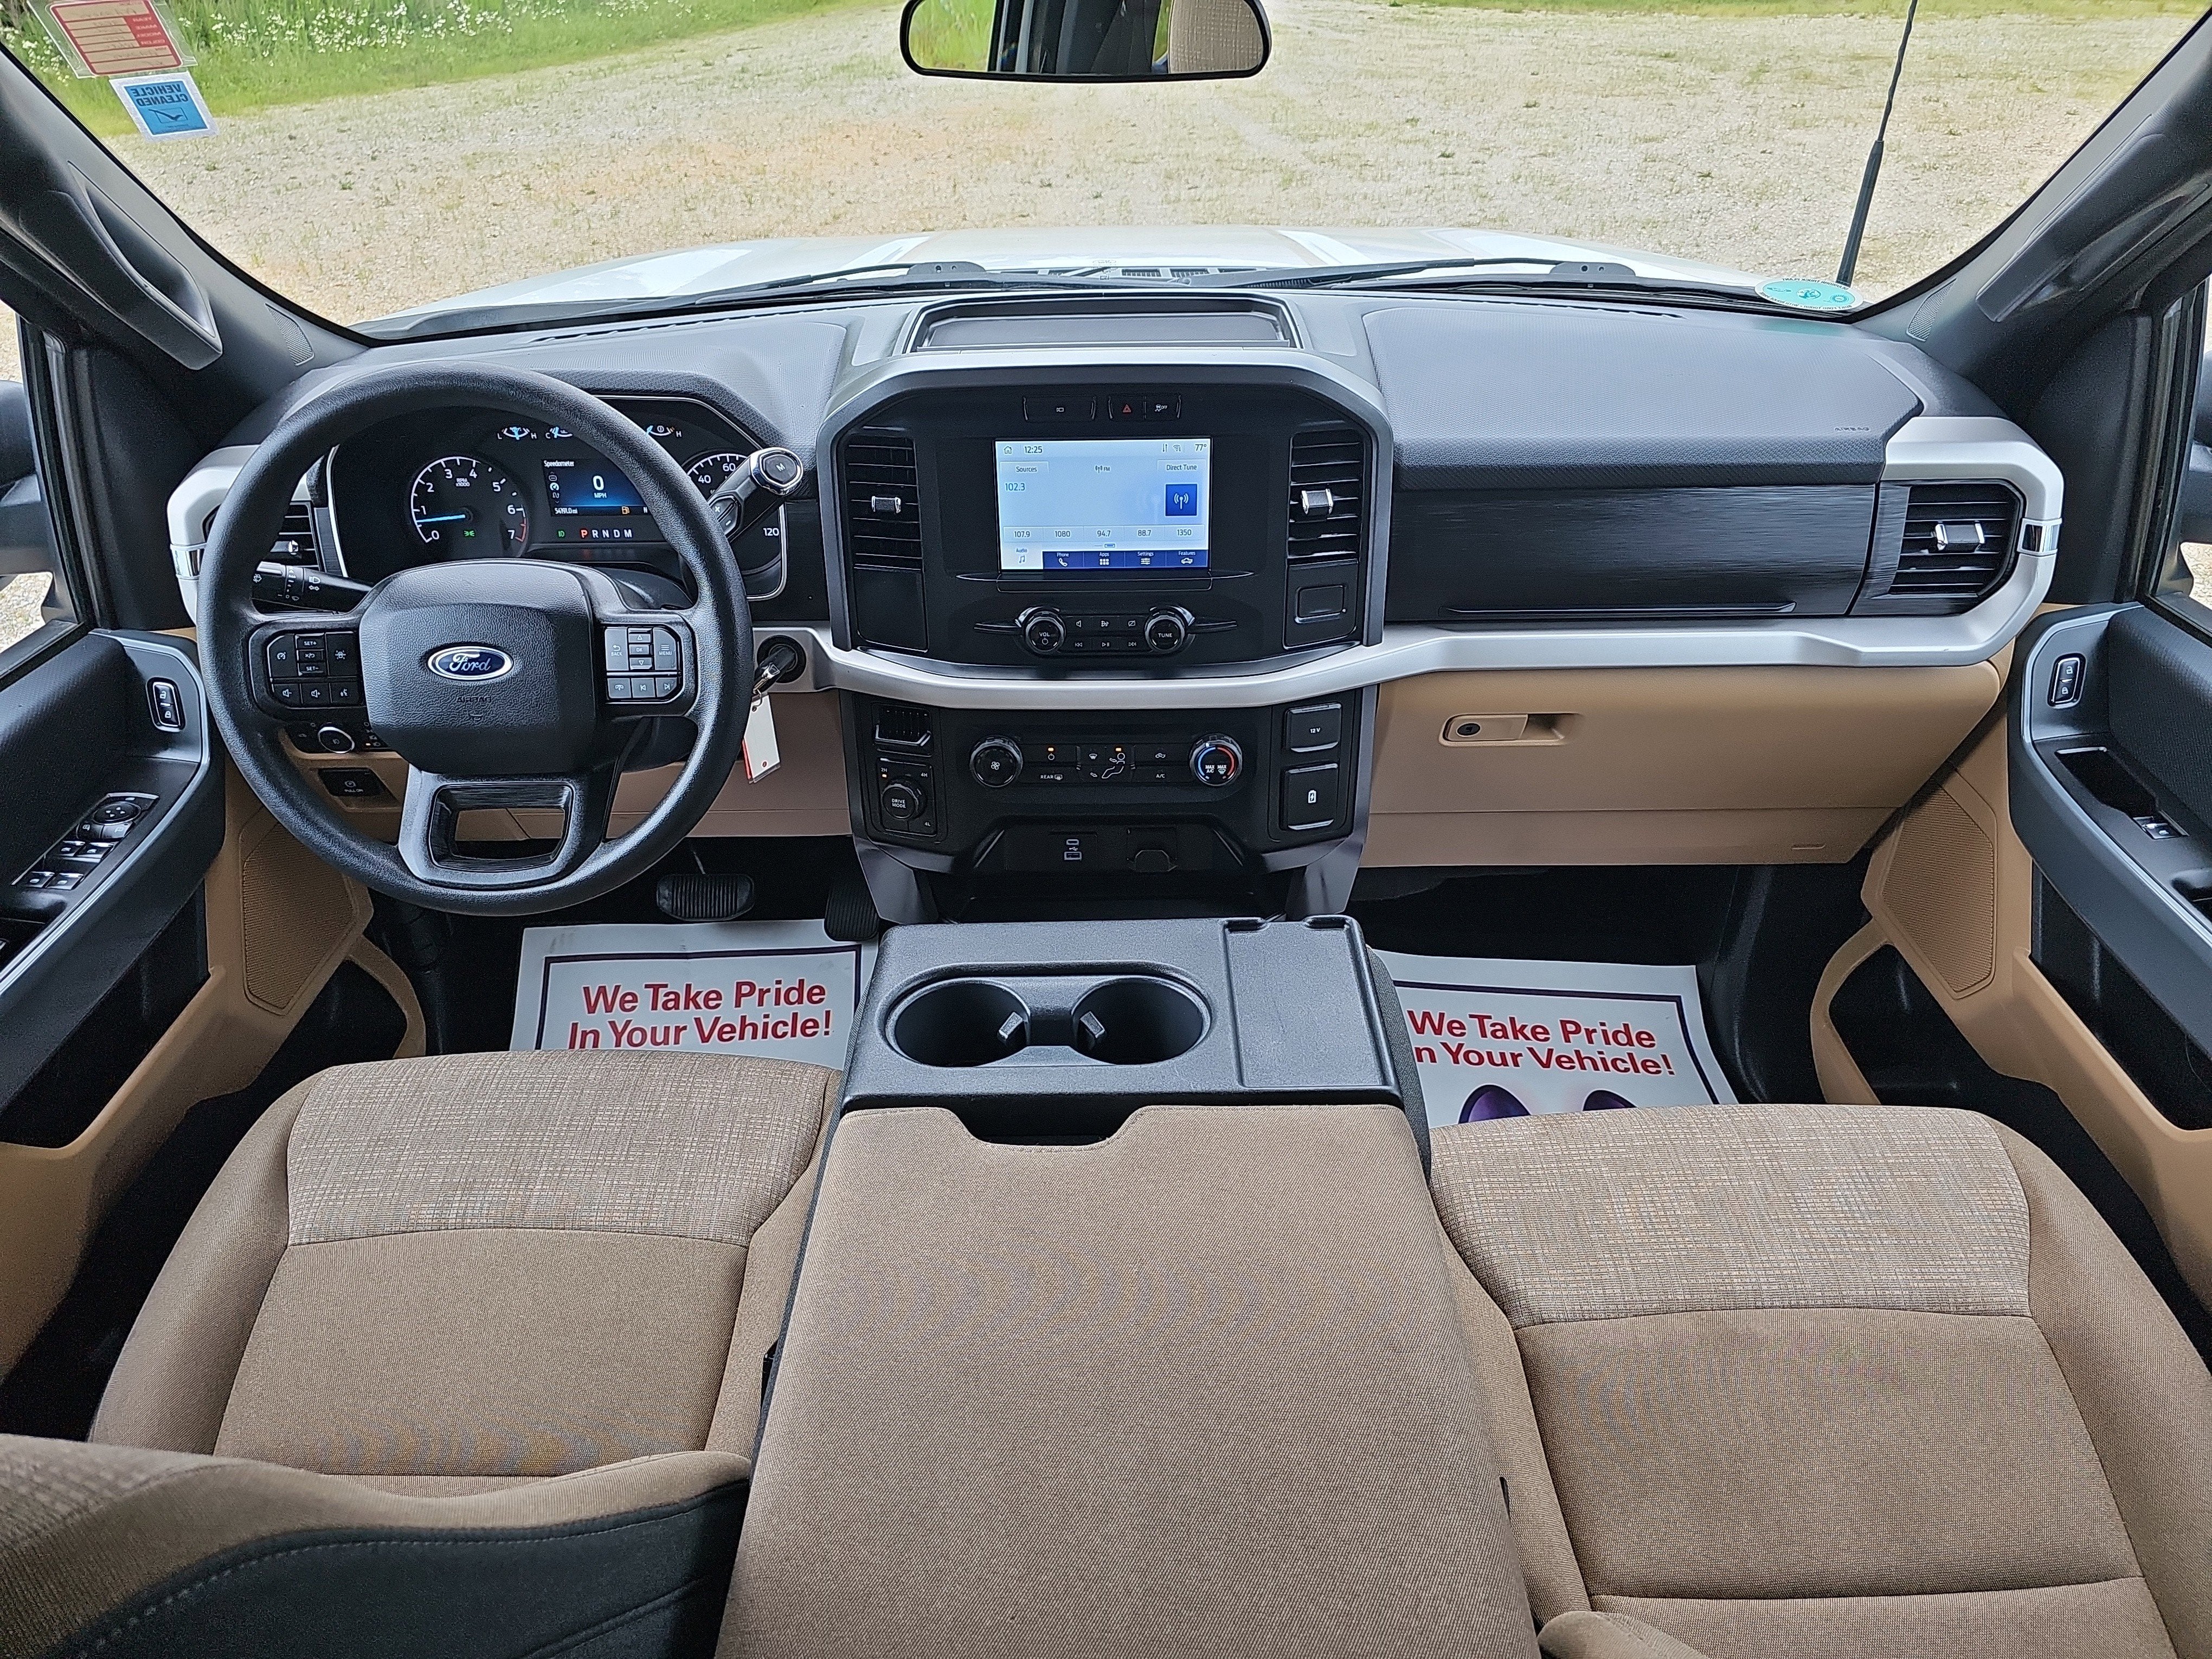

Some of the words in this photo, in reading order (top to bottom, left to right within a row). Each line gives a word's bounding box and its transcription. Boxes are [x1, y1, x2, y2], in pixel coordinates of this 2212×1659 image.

[723, 463, 736, 472] 60
[776, 463, 786, 472] M
[445, 468, 453, 479] 3
[469, 468, 478, 479] 4
[593, 475, 604, 490] 0
[698, 475, 711, 484] 40
[426, 483, 435, 492] 2
[493, 481, 501, 492] 5
[1005, 483, 1025, 491] 102.3
[421, 506, 427, 515] 1
[507, 504, 516, 515] 6
[431, 530, 440, 541] 0
[508, 529, 516, 540] 7
[581, 530, 588, 538] P
[592, 530, 599, 538] R
[602, 530, 609, 538] N
[613, 529, 620, 537] D
[623, 529, 632, 537] M
[763, 528, 780, 536] 120
[449, 652, 491, 671] Ford
[583, 984, 639, 1014] We
[645, 982, 723, 1011] Take
[734, 979, 826, 1008] Pride
[569, 1022, 600, 1049] In
[607, 1018, 687, 1048] Your
[693, 1010, 831, 1044] Vehicle!
[1407, 1010, 1467, 1037] We
[1468, 1013, 1551, 1043] Take
[1559, 1019, 1656, 1048] Pride
[1414, 1047, 1437, 1063] n
[1439, 1041, 1523, 1068] Your
[1526, 1046, 1675, 1076] Vehicle!
